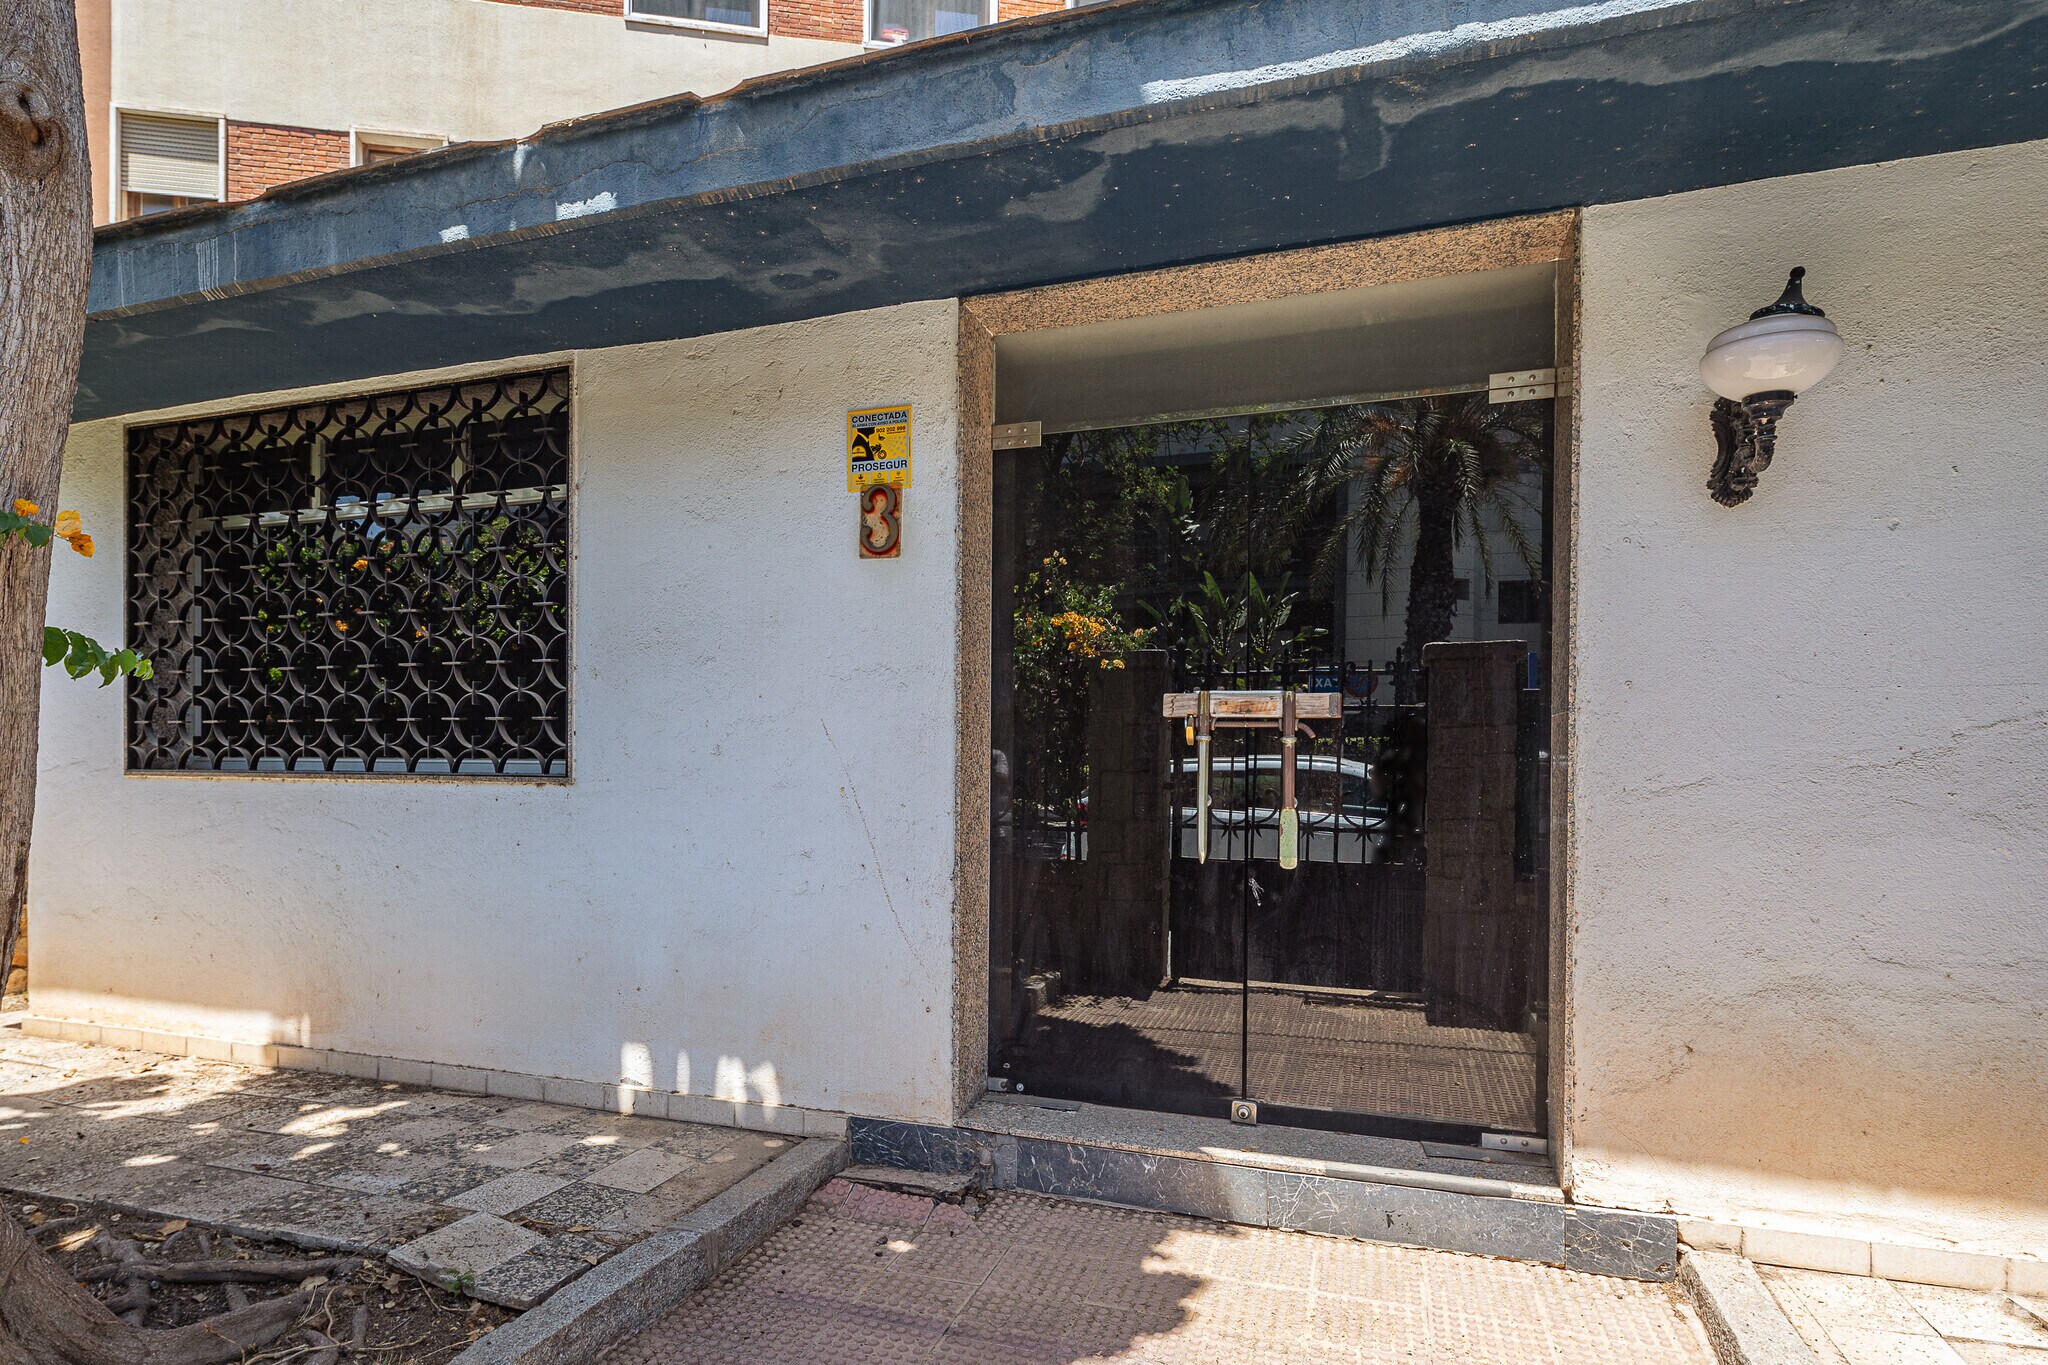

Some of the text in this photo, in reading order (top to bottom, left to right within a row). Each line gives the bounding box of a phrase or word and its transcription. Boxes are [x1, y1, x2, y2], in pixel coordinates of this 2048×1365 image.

[852, 411, 907, 423] CONECTADA
[852, 460, 907, 472] PROSEGUR
[860, 485, 899, 554] 3
